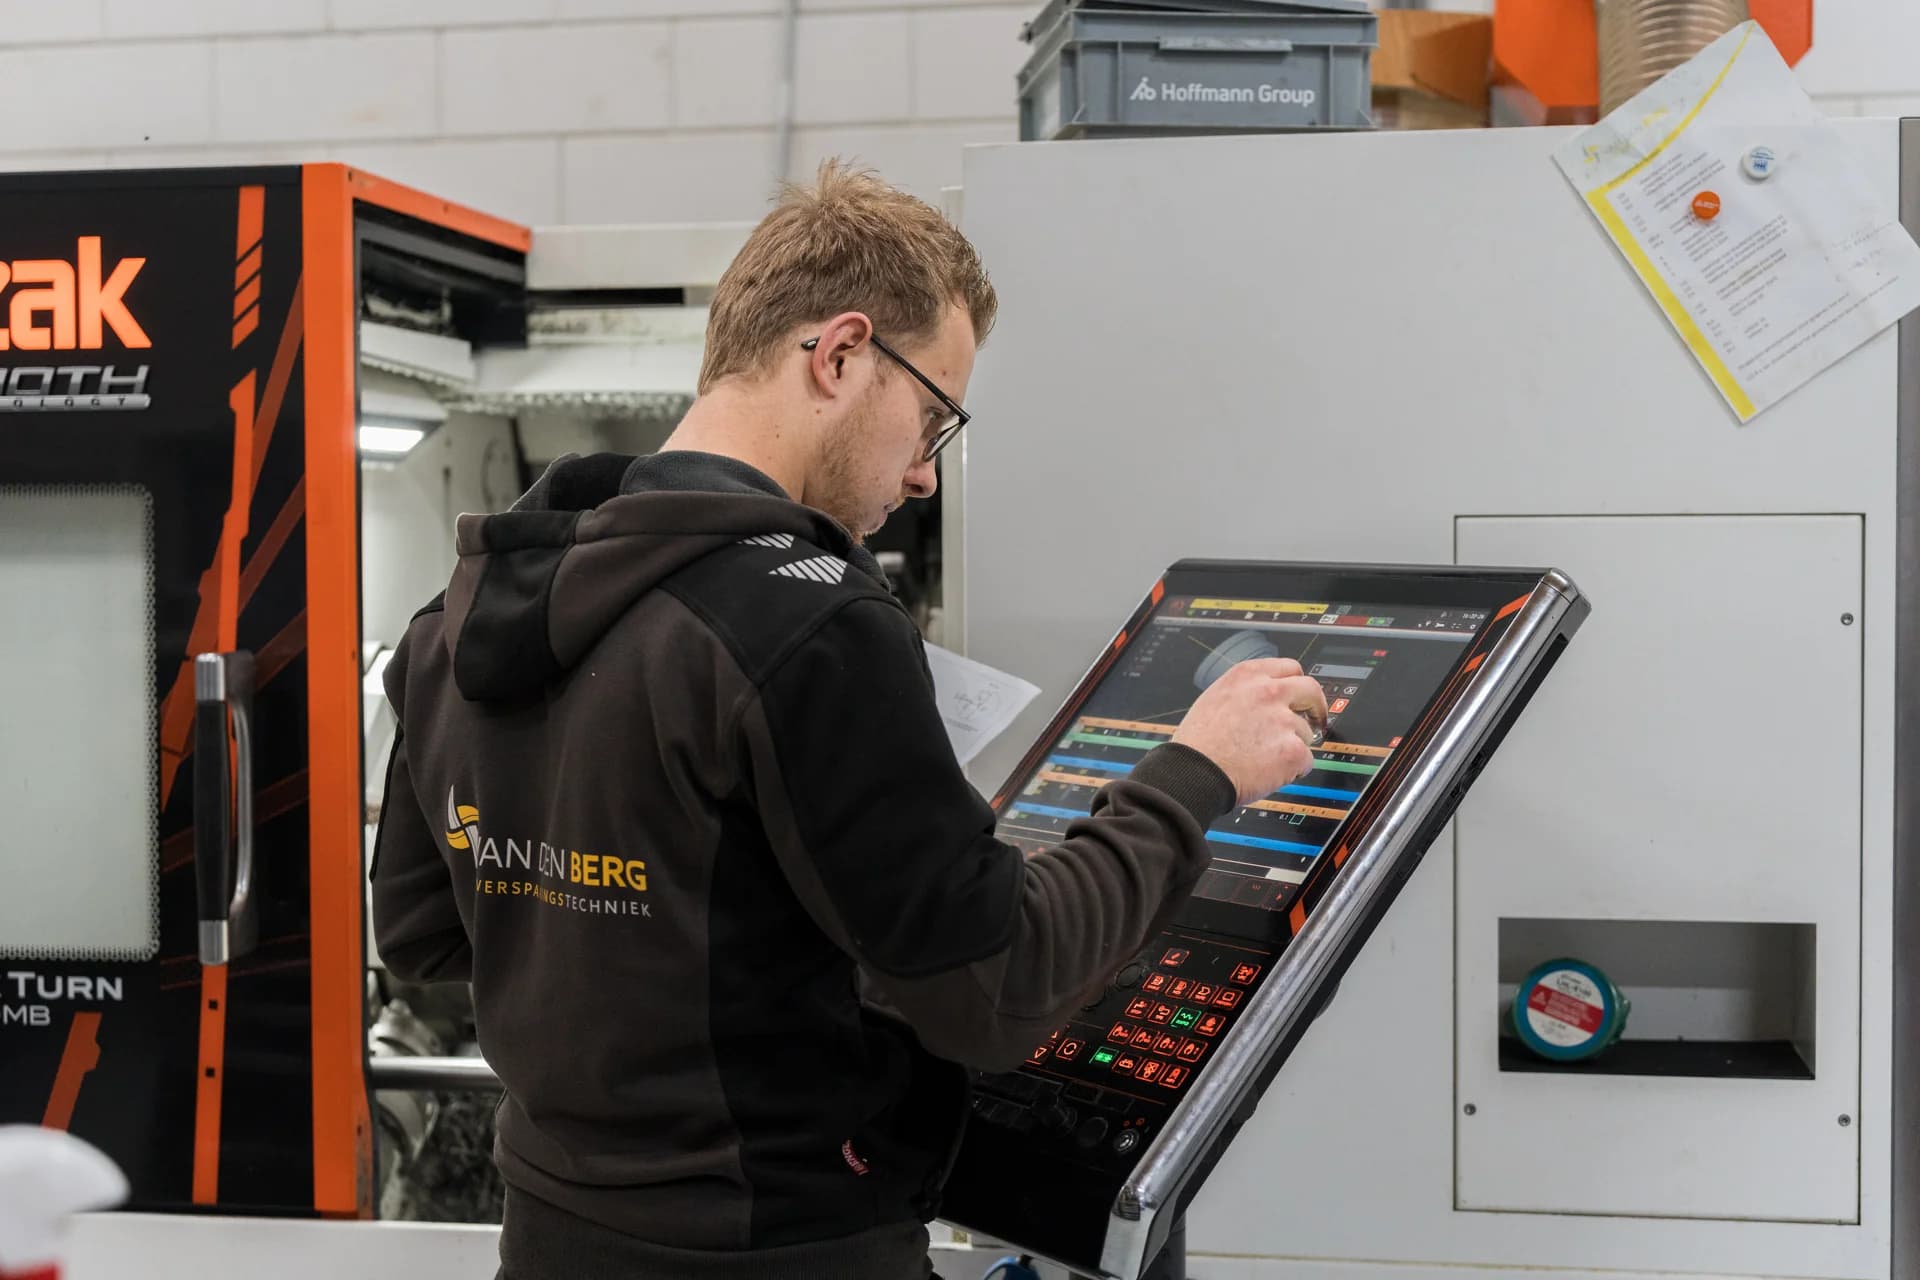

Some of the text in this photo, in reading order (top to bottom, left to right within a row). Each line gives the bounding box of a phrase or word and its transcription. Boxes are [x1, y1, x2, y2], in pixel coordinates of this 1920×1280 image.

[1161, 82, 1316, 107] Hoffmann Group
[0, 235, 153, 351] ak
[0, 364, 150, 396] OTH
[471, 835, 532, 870] VAN
[569, 850, 648, 892] BERG
[0, 1004, 51, 1027] MB
